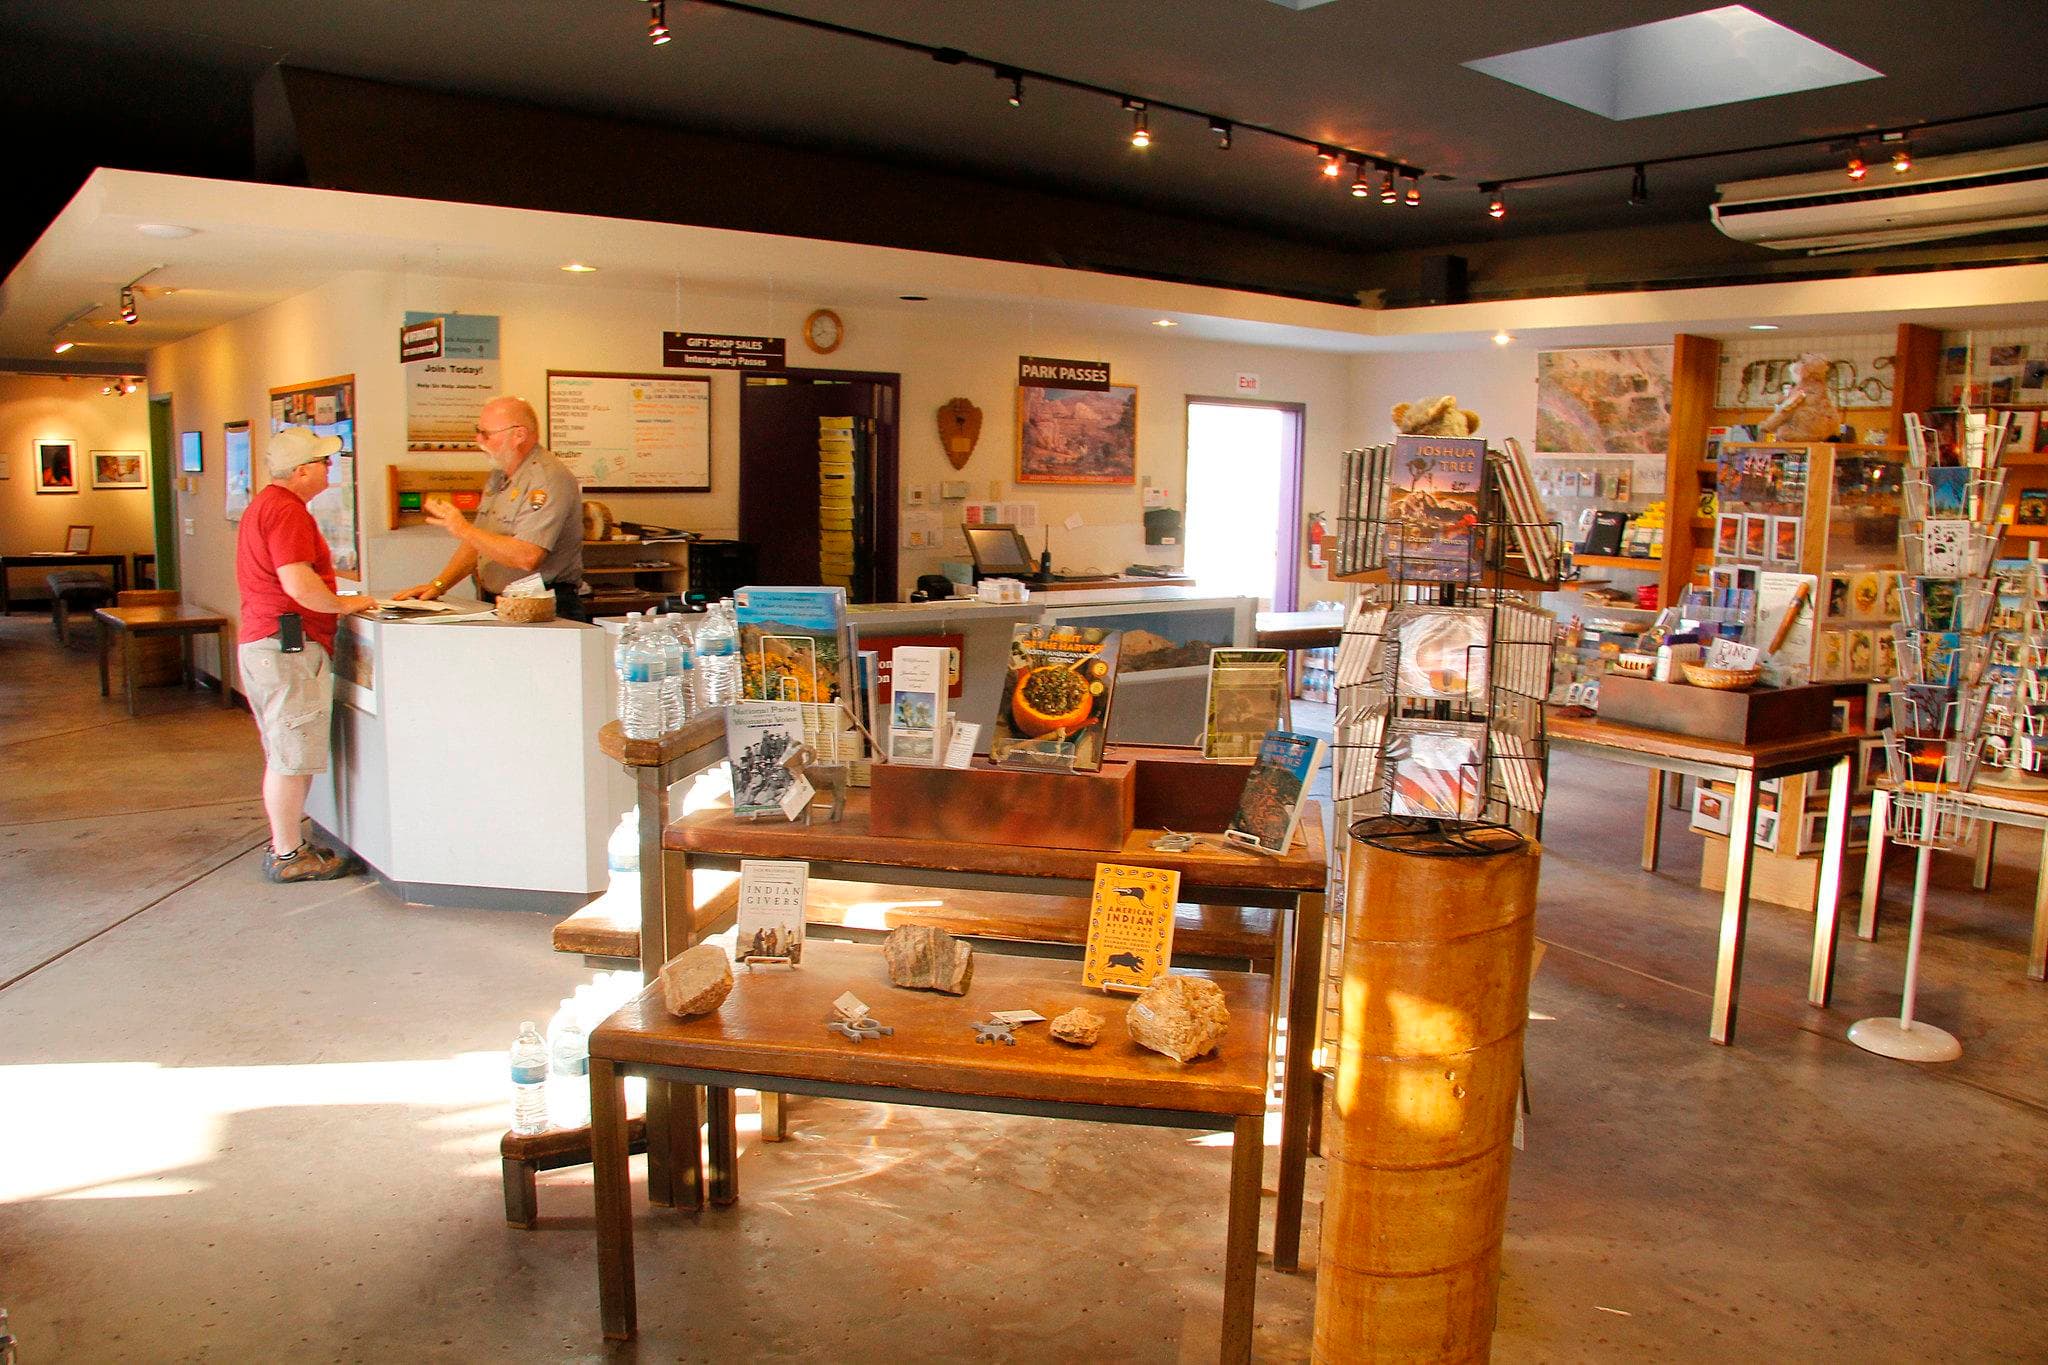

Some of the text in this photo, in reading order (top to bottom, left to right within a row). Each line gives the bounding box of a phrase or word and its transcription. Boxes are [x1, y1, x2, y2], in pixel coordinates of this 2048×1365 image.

[686, 338, 763, 350] GIFT SHOP SALES
[684, 354, 767, 366] Interagency Passes
[424, 364, 484, 375] Join Today!
[1022, 364, 1107, 382] PARK PASSES
[1416, 445, 1476, 458] JOSHUA
[1440, 460, 1474, 473] TREE
[733, 707, 769, 715] National
[747, 885, 801, 896] INDIAN
[747, 896, 799, 906] GIVERS
[1108, 906, 1155, 917] AMERICAN
[1107, 913, 1154, 926] INDIAN
